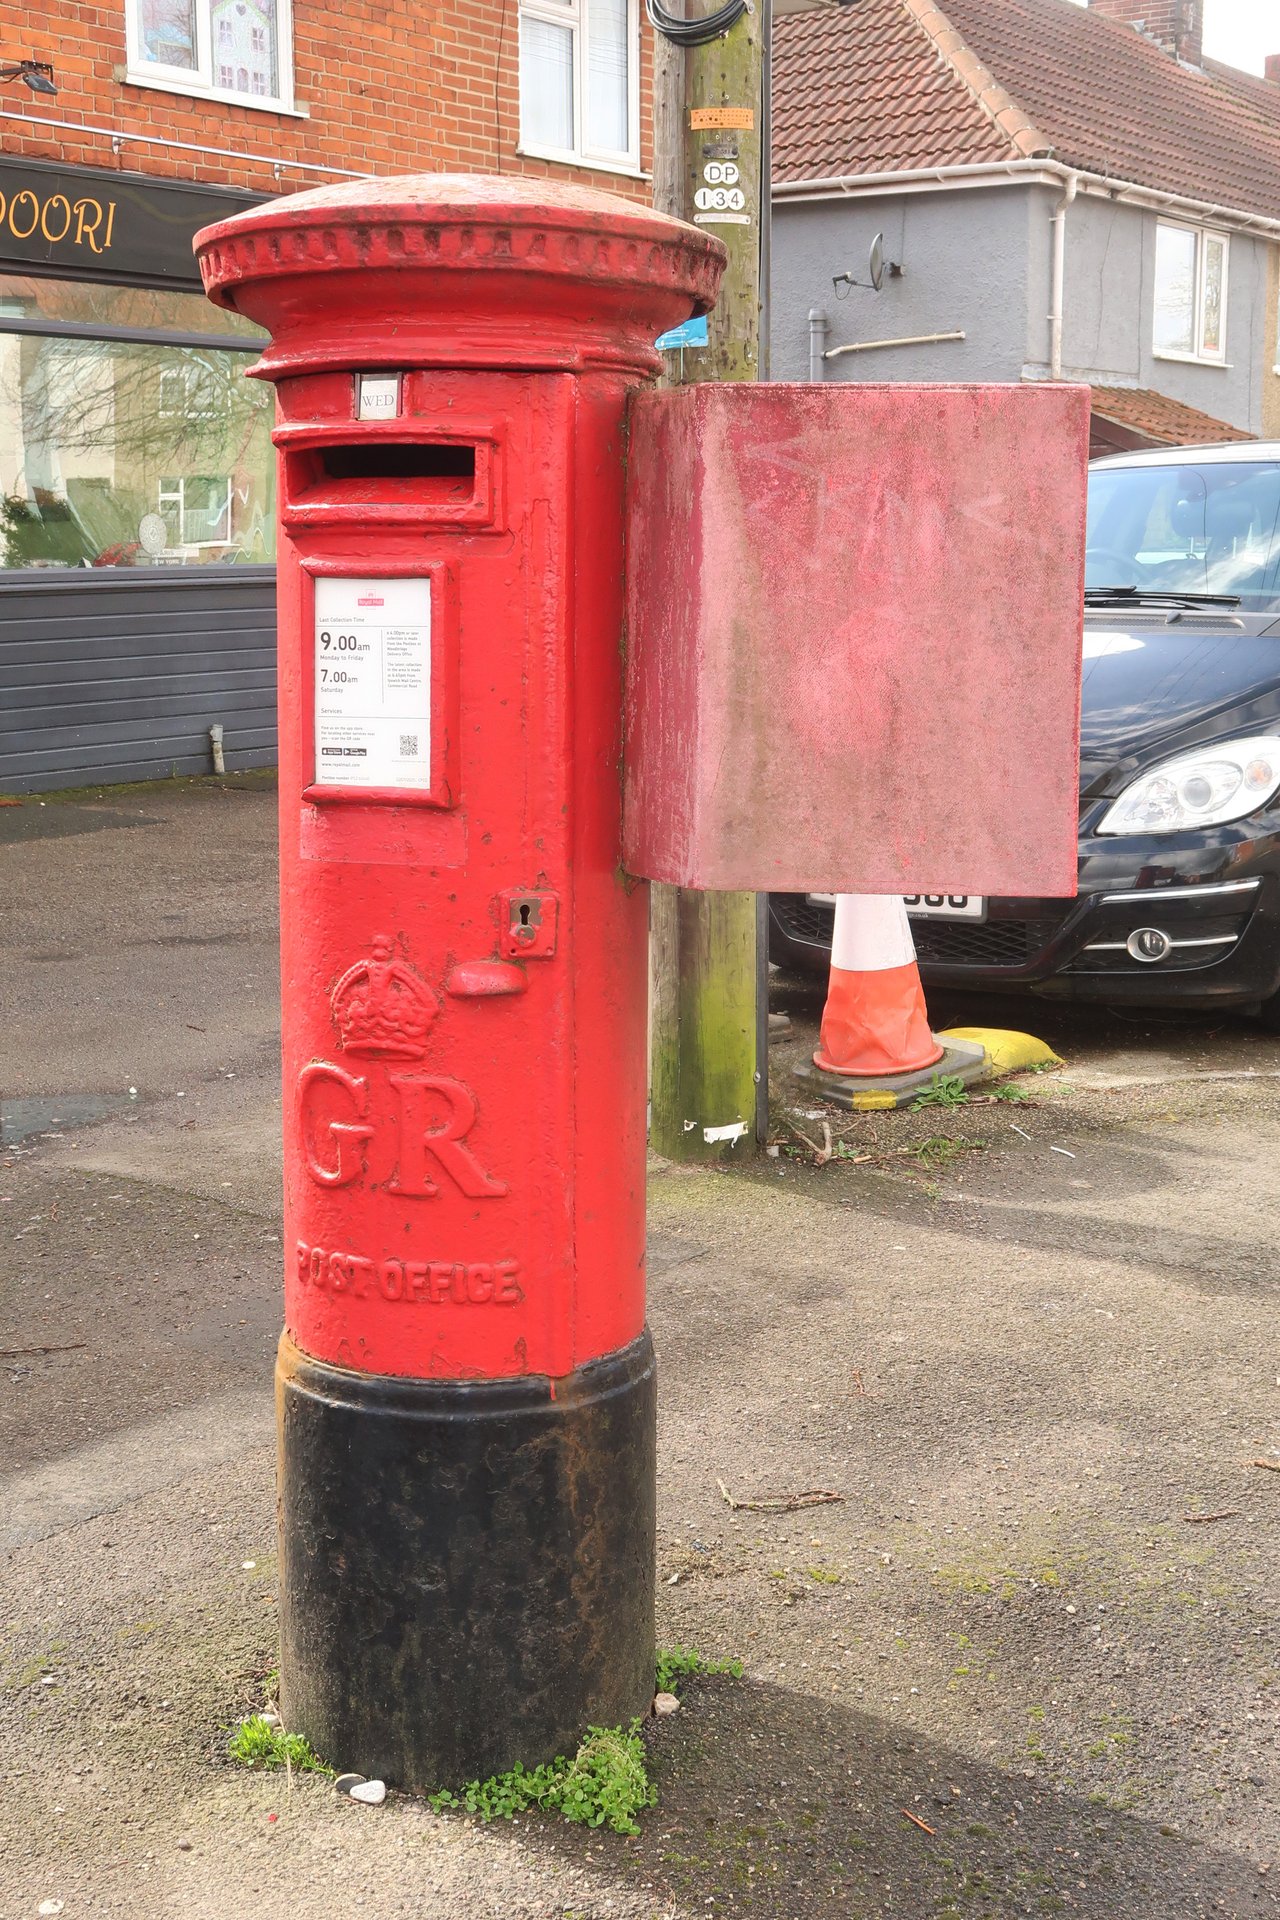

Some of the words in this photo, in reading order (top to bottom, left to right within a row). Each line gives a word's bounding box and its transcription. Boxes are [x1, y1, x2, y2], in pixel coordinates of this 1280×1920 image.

[709, 166, 735, 180] DP
[703, 192, 739, 206] 134
[362, 395, 394, 406] WED
[378, 1257, 525, 1302] OFFICE
